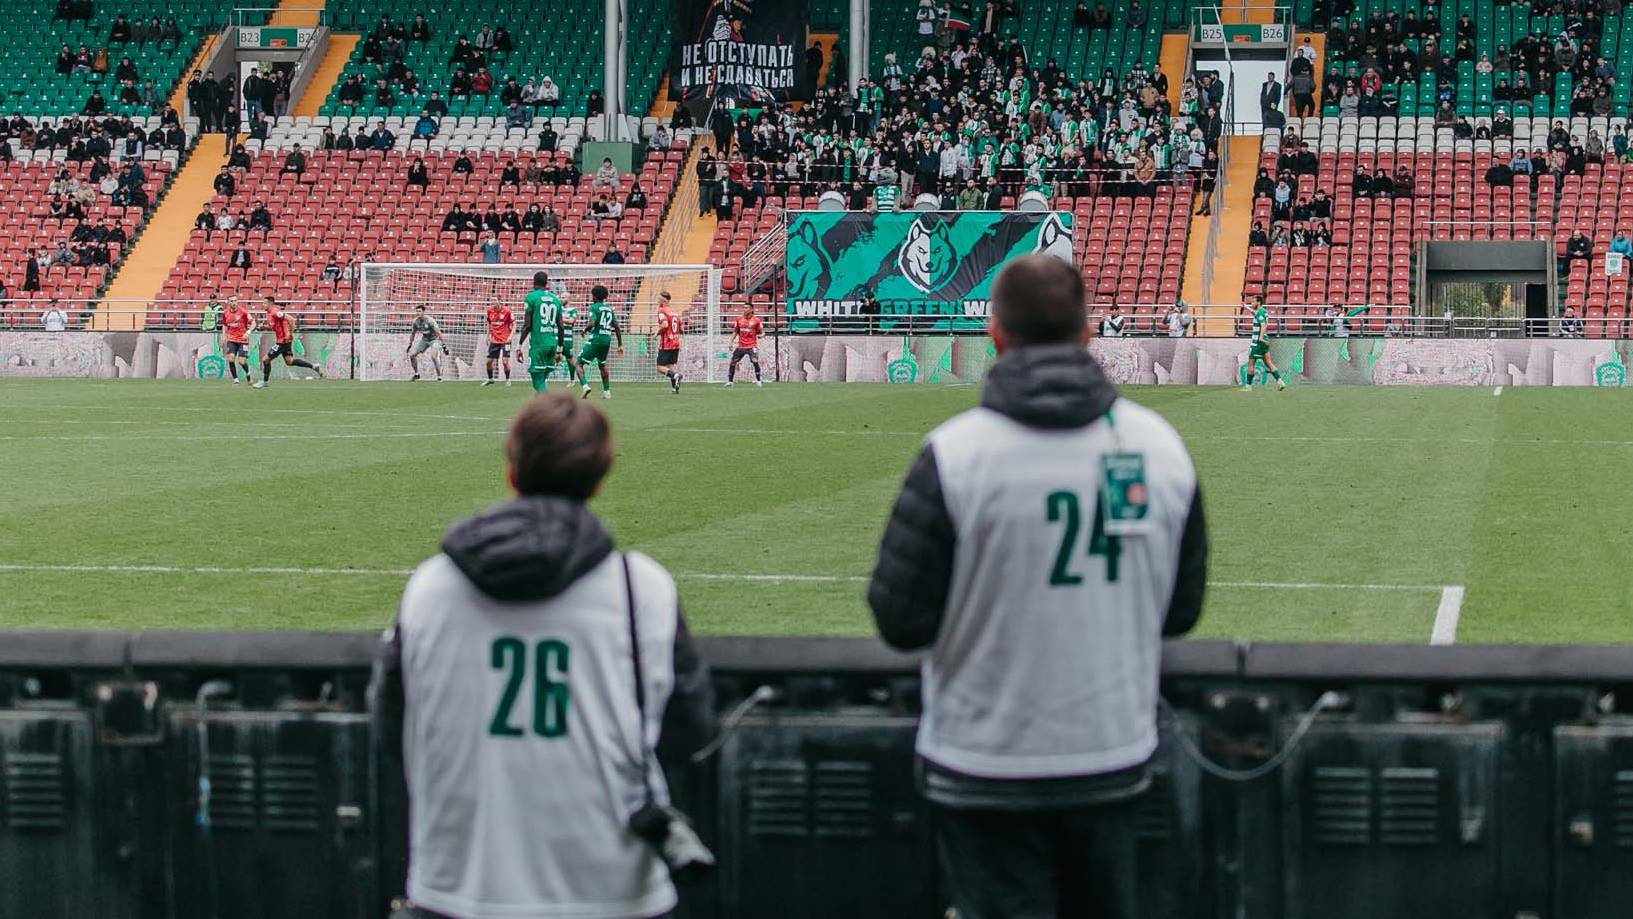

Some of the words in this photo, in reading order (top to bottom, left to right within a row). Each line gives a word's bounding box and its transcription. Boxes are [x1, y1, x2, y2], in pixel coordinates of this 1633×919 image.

[241, 33, 259, 43] B23
[1203, 29, 1222, 39] B25
[1263, 29, 1283, 39] B26
[683, 44, 702, 66] НЕ
[708, 41, 793, 67] ОТСТУПАТЬ
[681, 68, 691, 87] И
[695, 66, 712, 85] НЕ
[717, 65, 794, 88] СДАВАТЬСЯ
[540, 303, 558, 325] 90
[880, 300, 951, 317] GREEN
[599, 311, 613, 330] 42
[671, 317, 678, 334] 6
[1046, 490, 1122, 585] 24
[489, 637, 570, 738] 26
